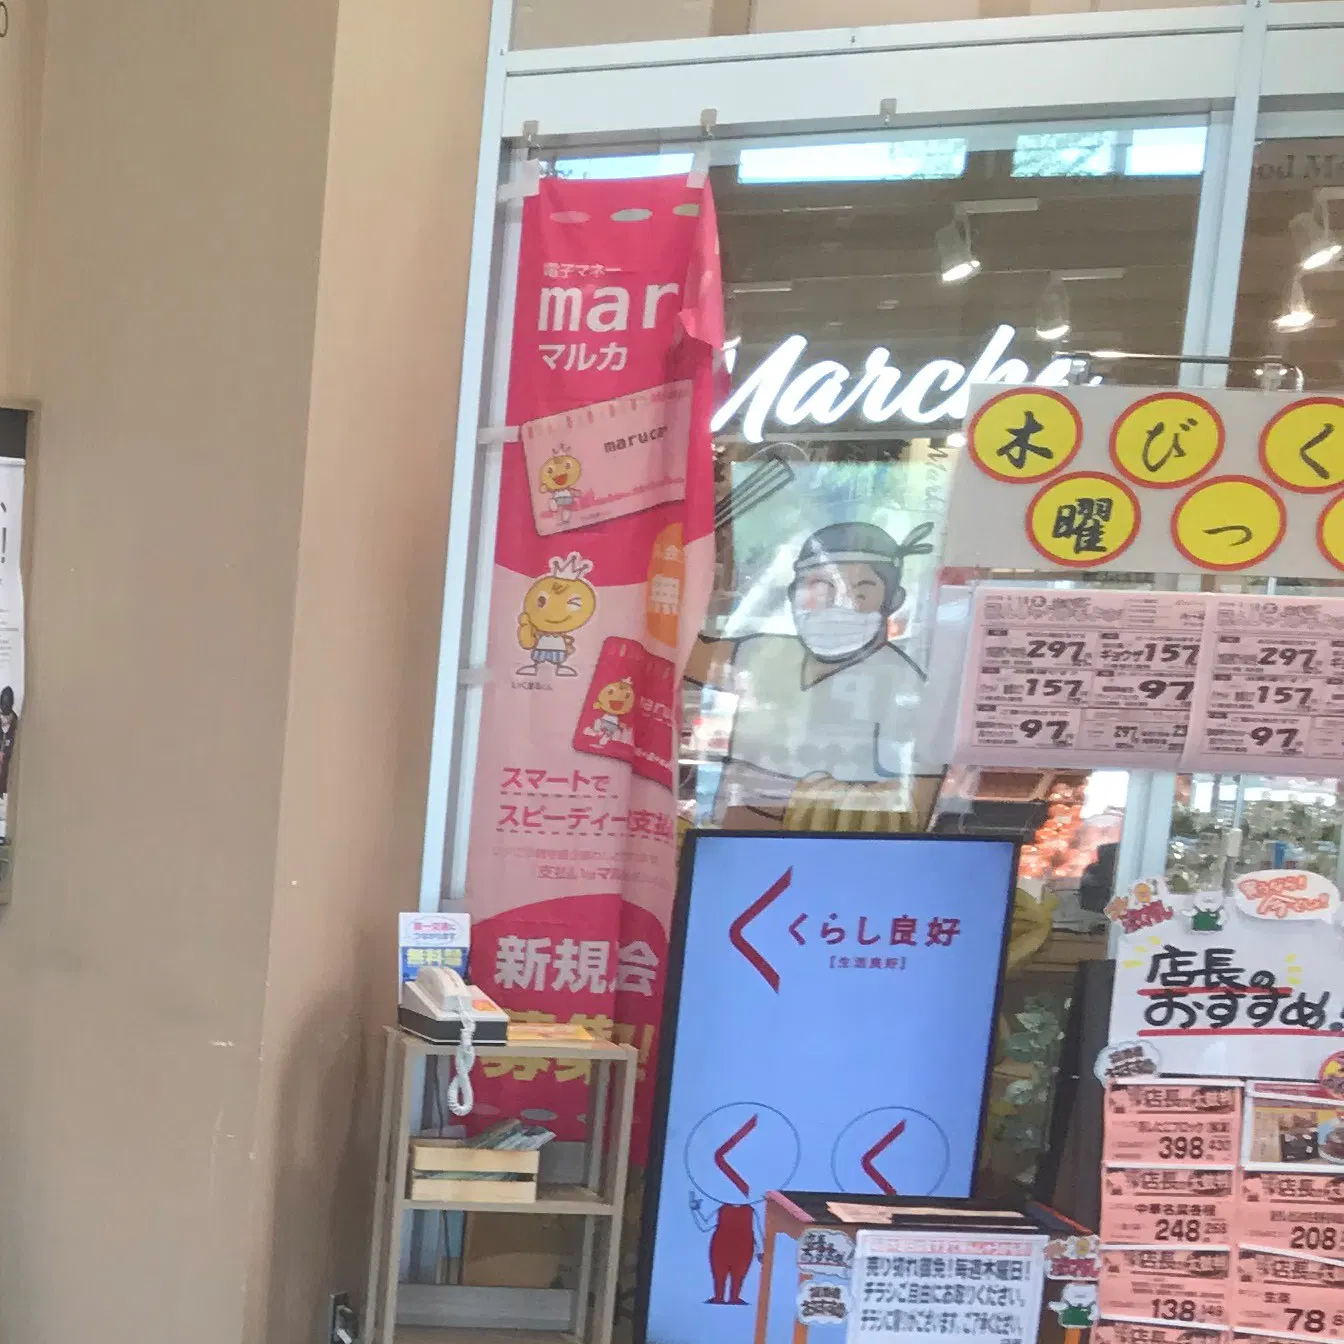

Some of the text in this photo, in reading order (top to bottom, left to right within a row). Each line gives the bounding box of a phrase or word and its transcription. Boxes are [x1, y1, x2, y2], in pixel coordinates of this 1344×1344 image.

[537, 341, 628, 373] マルカ
[1026, 639, 1087, 663] 297
[1257, 646, 1318, 673] 297
[1024, 678, 1316, 706] 157 97 157
[1018, 718, 1300, 749] 97 97
[500, 766, 611, 793] スマートで
[787, 911, 962, 949] くらし良好
[1145, 944, 1277, 992] 店長の
[1158, 1135, 1204, 1160] 398
[1154, 1218, 1201, 1243] 248
[1289, 1225, 1337, 1251] 208
[1150, 1298, 1196, 1322] 138
[1283, 1306, 1326, 1334] 78
